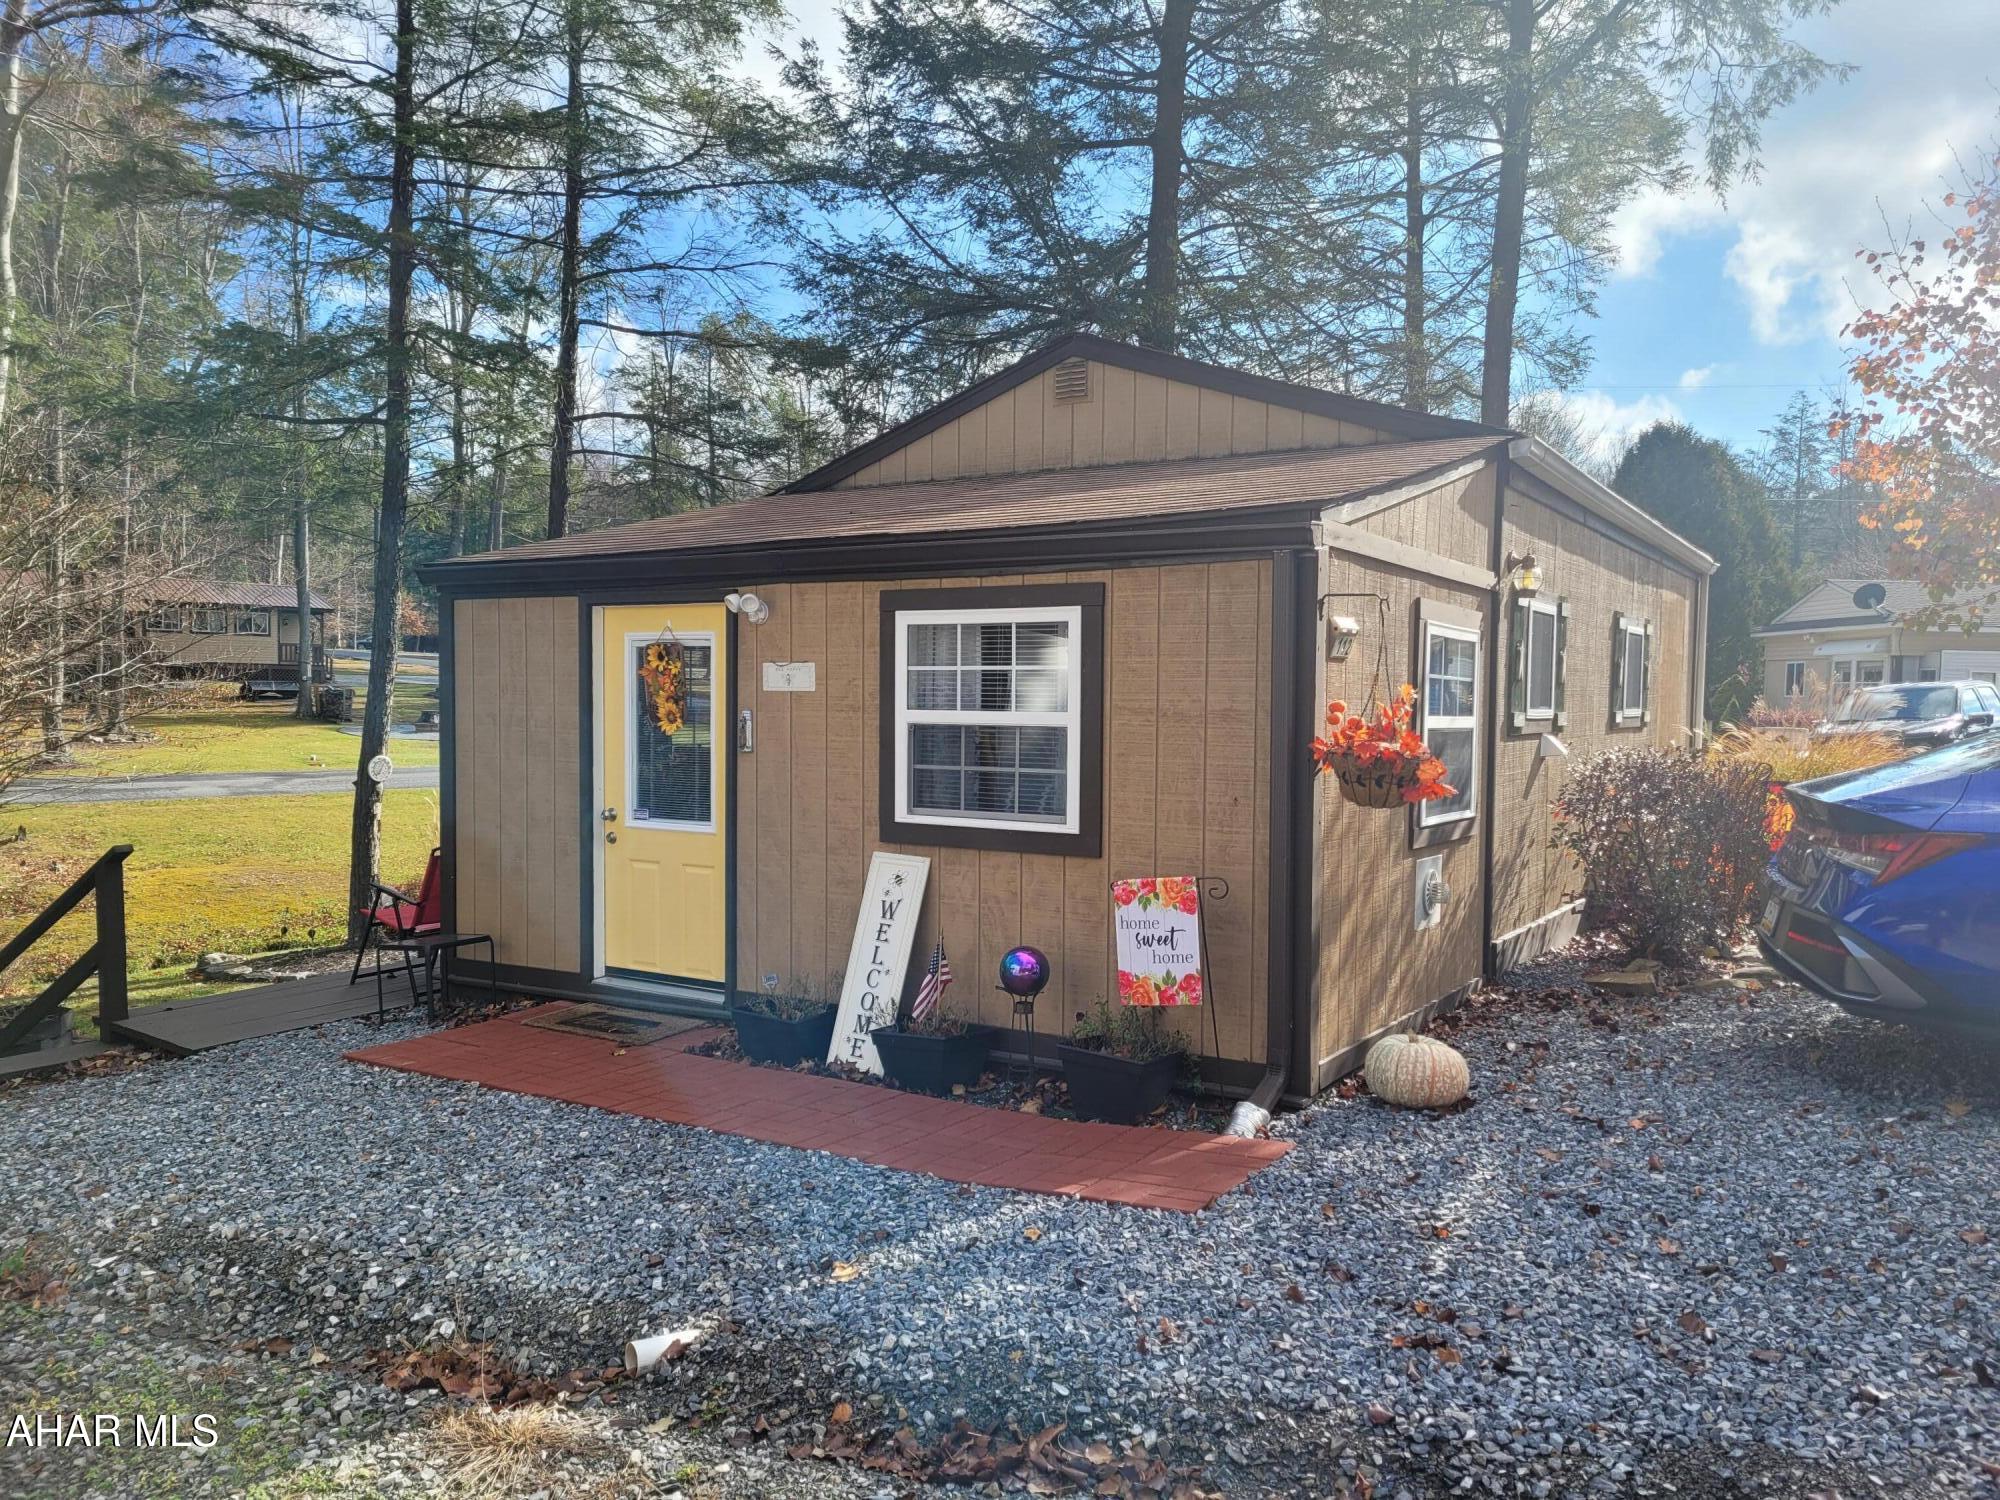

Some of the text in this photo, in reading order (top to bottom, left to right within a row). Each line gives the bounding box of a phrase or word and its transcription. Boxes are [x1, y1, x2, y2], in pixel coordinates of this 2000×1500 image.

[1120, 915, 1160, 930] home
[1135, 926, 1186, 951] sweet
[1152, 950, 1194, 965] home
[850, 899, 903, 1059] WELCOME
